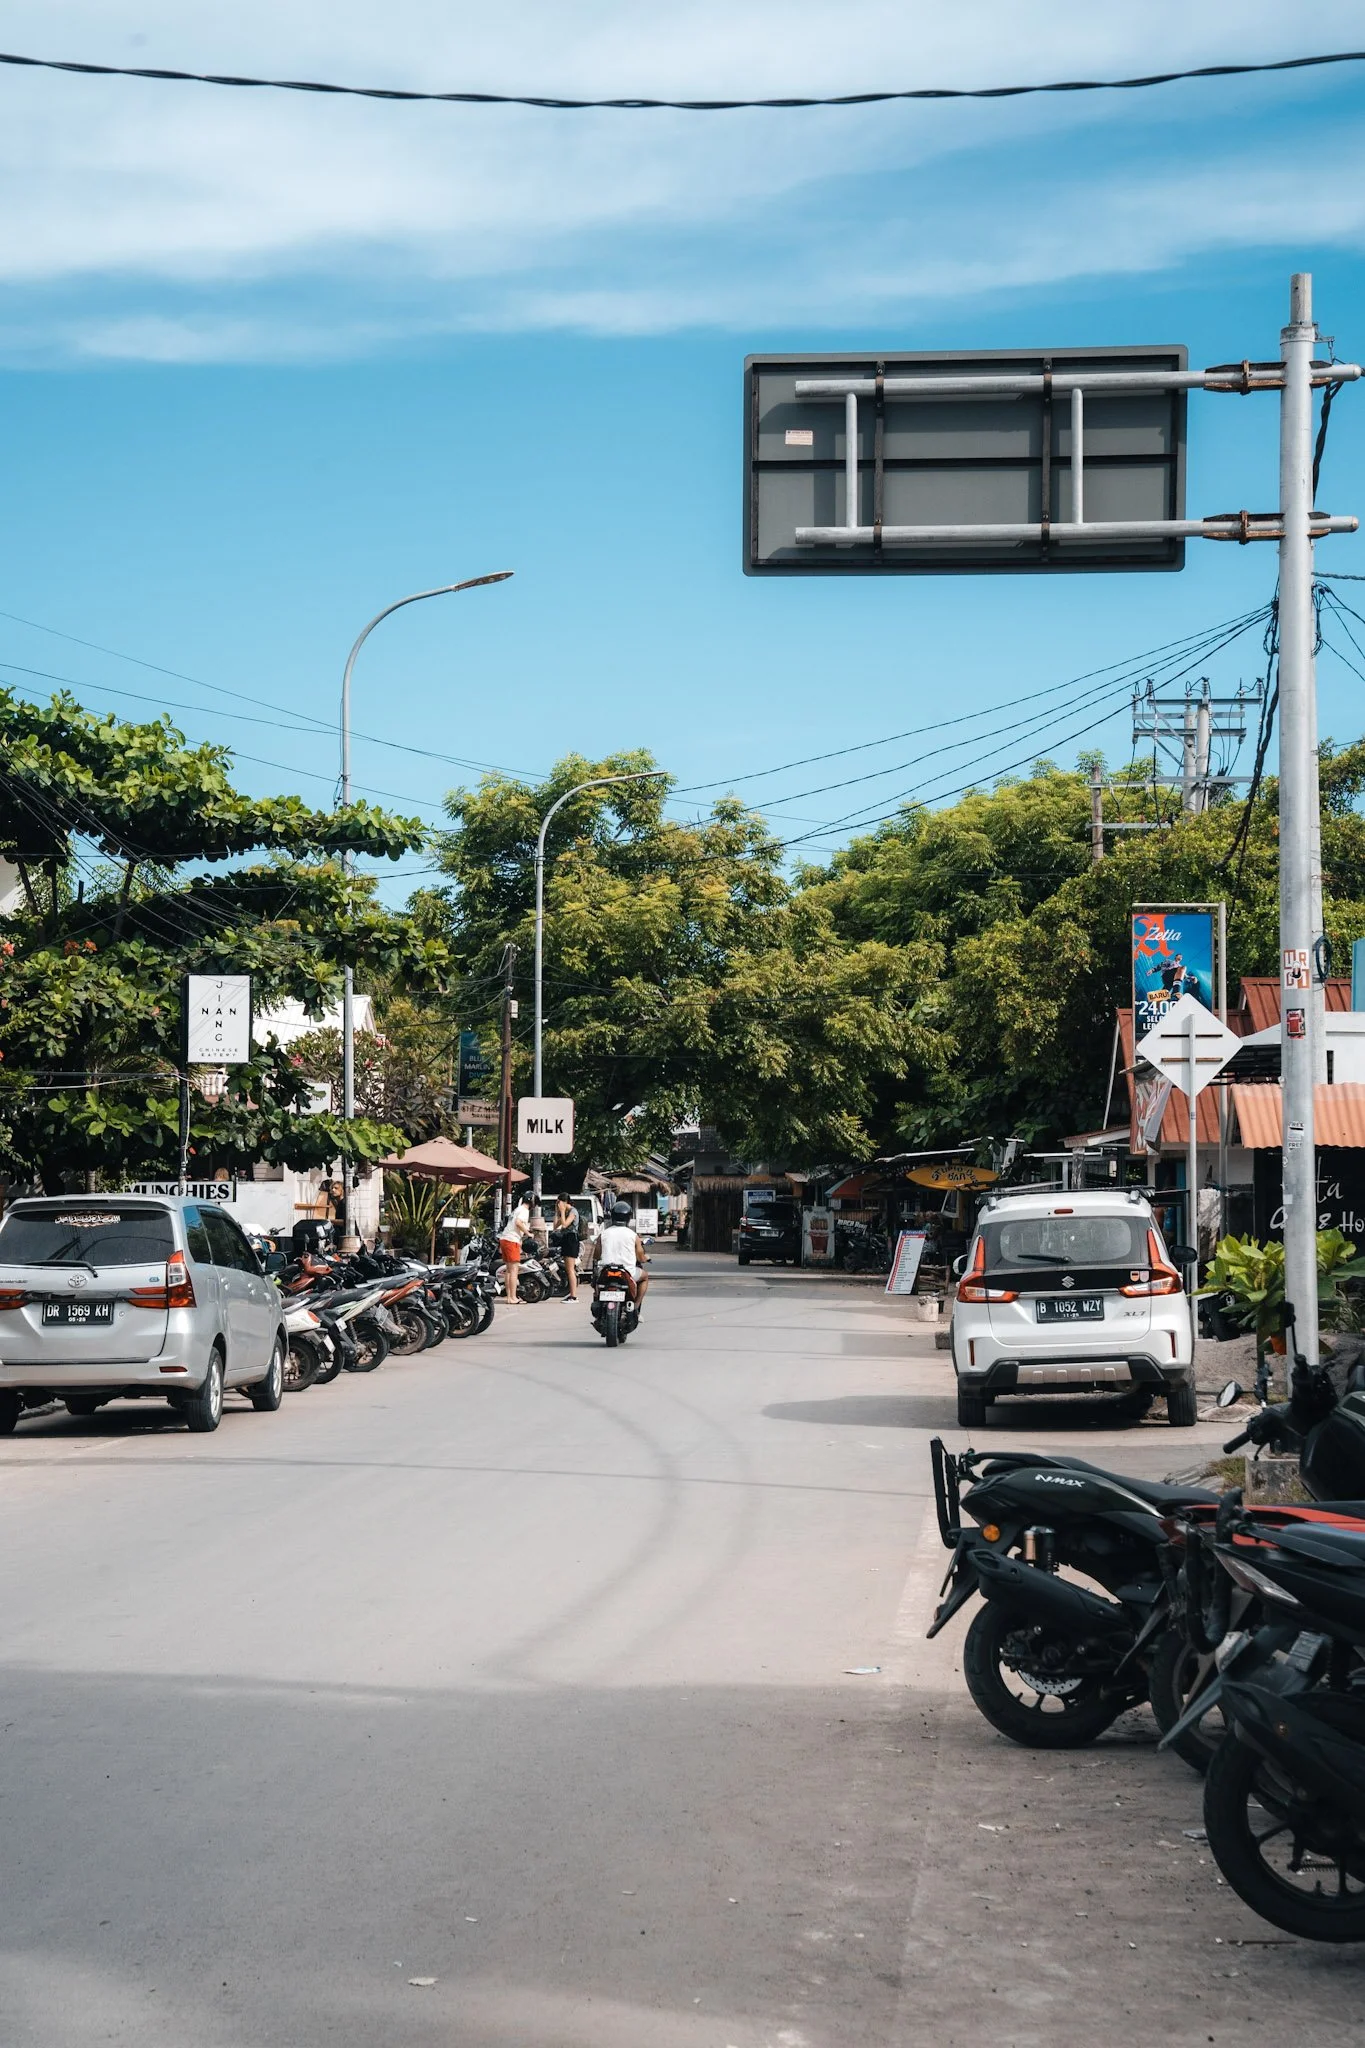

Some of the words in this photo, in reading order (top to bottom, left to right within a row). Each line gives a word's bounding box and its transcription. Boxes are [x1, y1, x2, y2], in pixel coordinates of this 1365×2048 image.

[526, 1119, 564, 1134] MILK
[47, 1305, 59, 1317] DR
[67, 1304, 91, 1317] 1569
[95, 1304, 109, 1317] KH
[1040, 1303, 1047, 1314] B
[1054, 1301, 1078, 1313] 1052
[1083, 1299, 1101, 1312] WZY
[1034, 1473, 1086, 1488] NMAX
